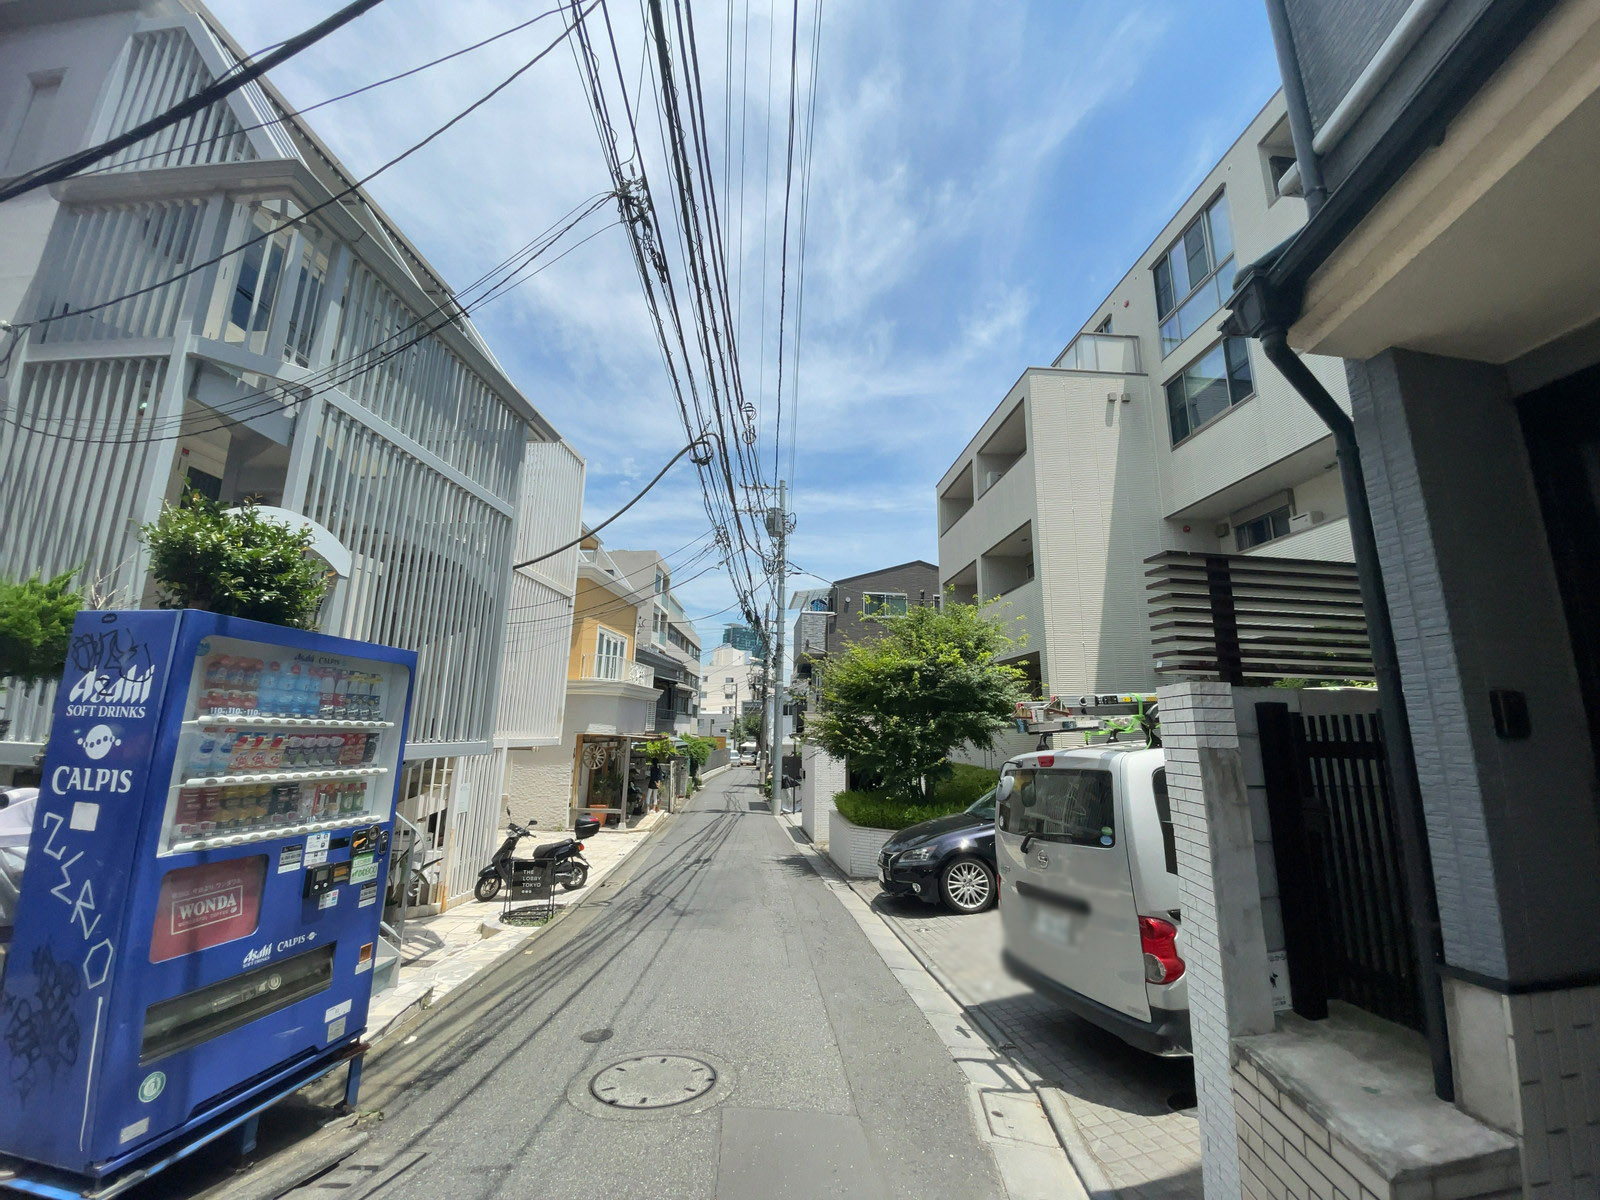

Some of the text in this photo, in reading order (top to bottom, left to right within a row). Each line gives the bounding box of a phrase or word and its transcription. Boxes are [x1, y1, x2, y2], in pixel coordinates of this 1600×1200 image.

[69, 664, 155, 704] Asahi
[66, 704, 146, 719] SOFT DRINKS
[51, 765, 133, 795] CALPIS
[179, 893, 237, 921] WONDA
[243, 934, 306, 964] Asahi CALPIS
